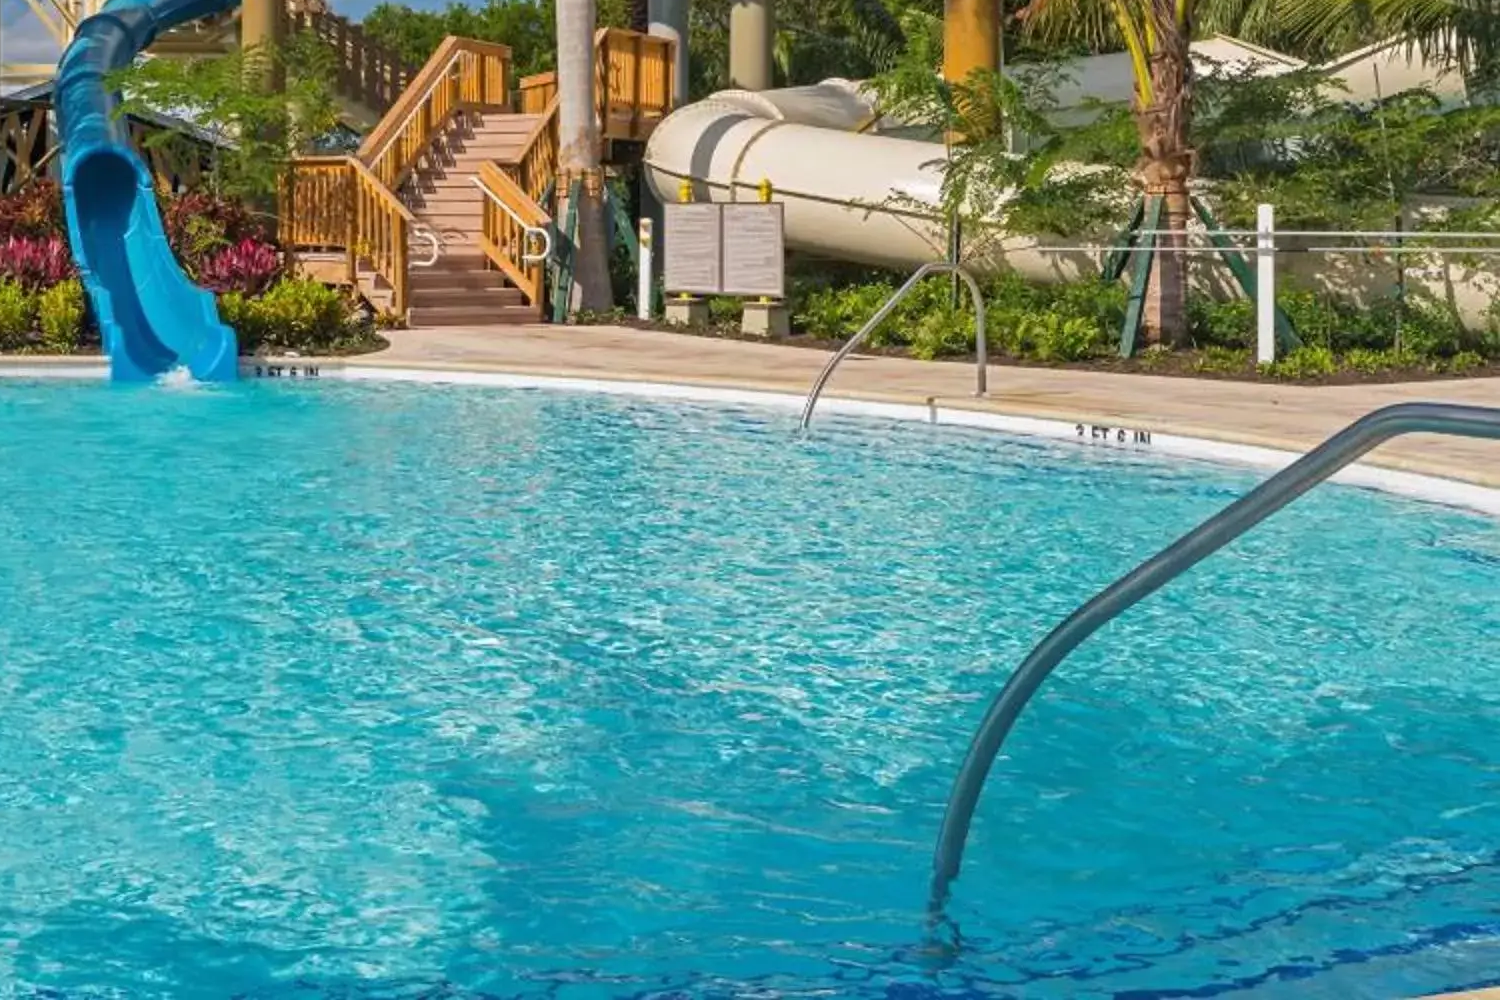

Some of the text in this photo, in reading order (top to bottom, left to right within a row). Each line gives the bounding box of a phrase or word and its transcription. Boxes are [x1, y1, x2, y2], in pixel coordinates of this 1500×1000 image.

[267, 366, 284, 377] FT
[303, 366, 319, 377] IN
[1091, 425, 1109, 440] FT
[1134, 431, 1151, 444] IN
